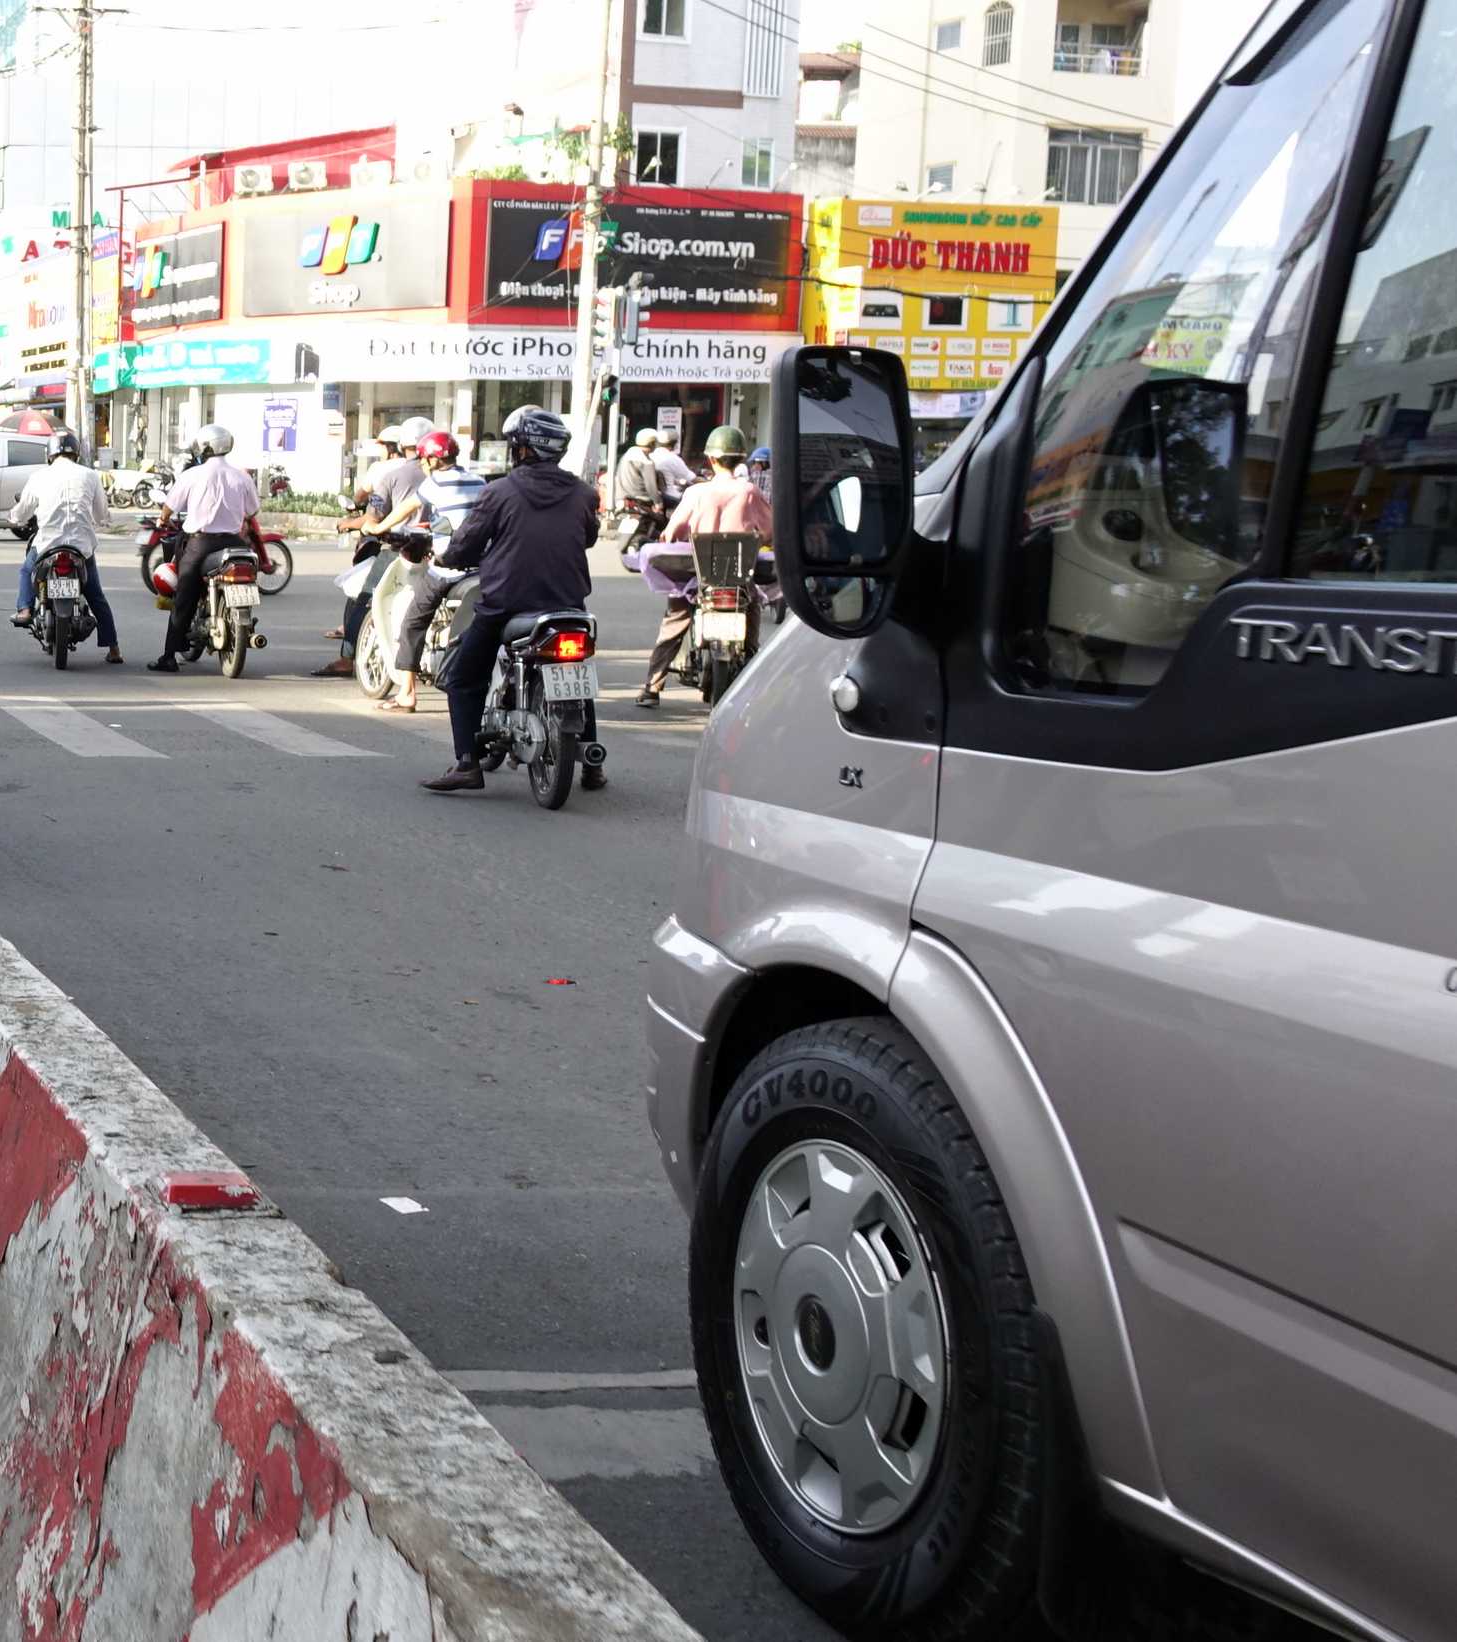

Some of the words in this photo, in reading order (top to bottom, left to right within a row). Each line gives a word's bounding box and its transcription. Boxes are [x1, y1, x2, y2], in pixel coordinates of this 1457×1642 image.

[621, 231, 755, 260] Shop.com.vn
[869, 229, 927, 270] ĐỨC
[937, 239, 1030, 273] THANH
[309, 281, 361, 307] Shop
[513, 337, 604, 357] iPhoe
[634, 339, 699, 359] chính
[708, 339, 766, 364] hãng
[469, 364, 507, 376] hành
[678, 364, 708, 379] hoặc
[713, 365, 731, 377] Trả
[735, 365, 761, 379] góp
[554, 682, 591, 697] 6386
